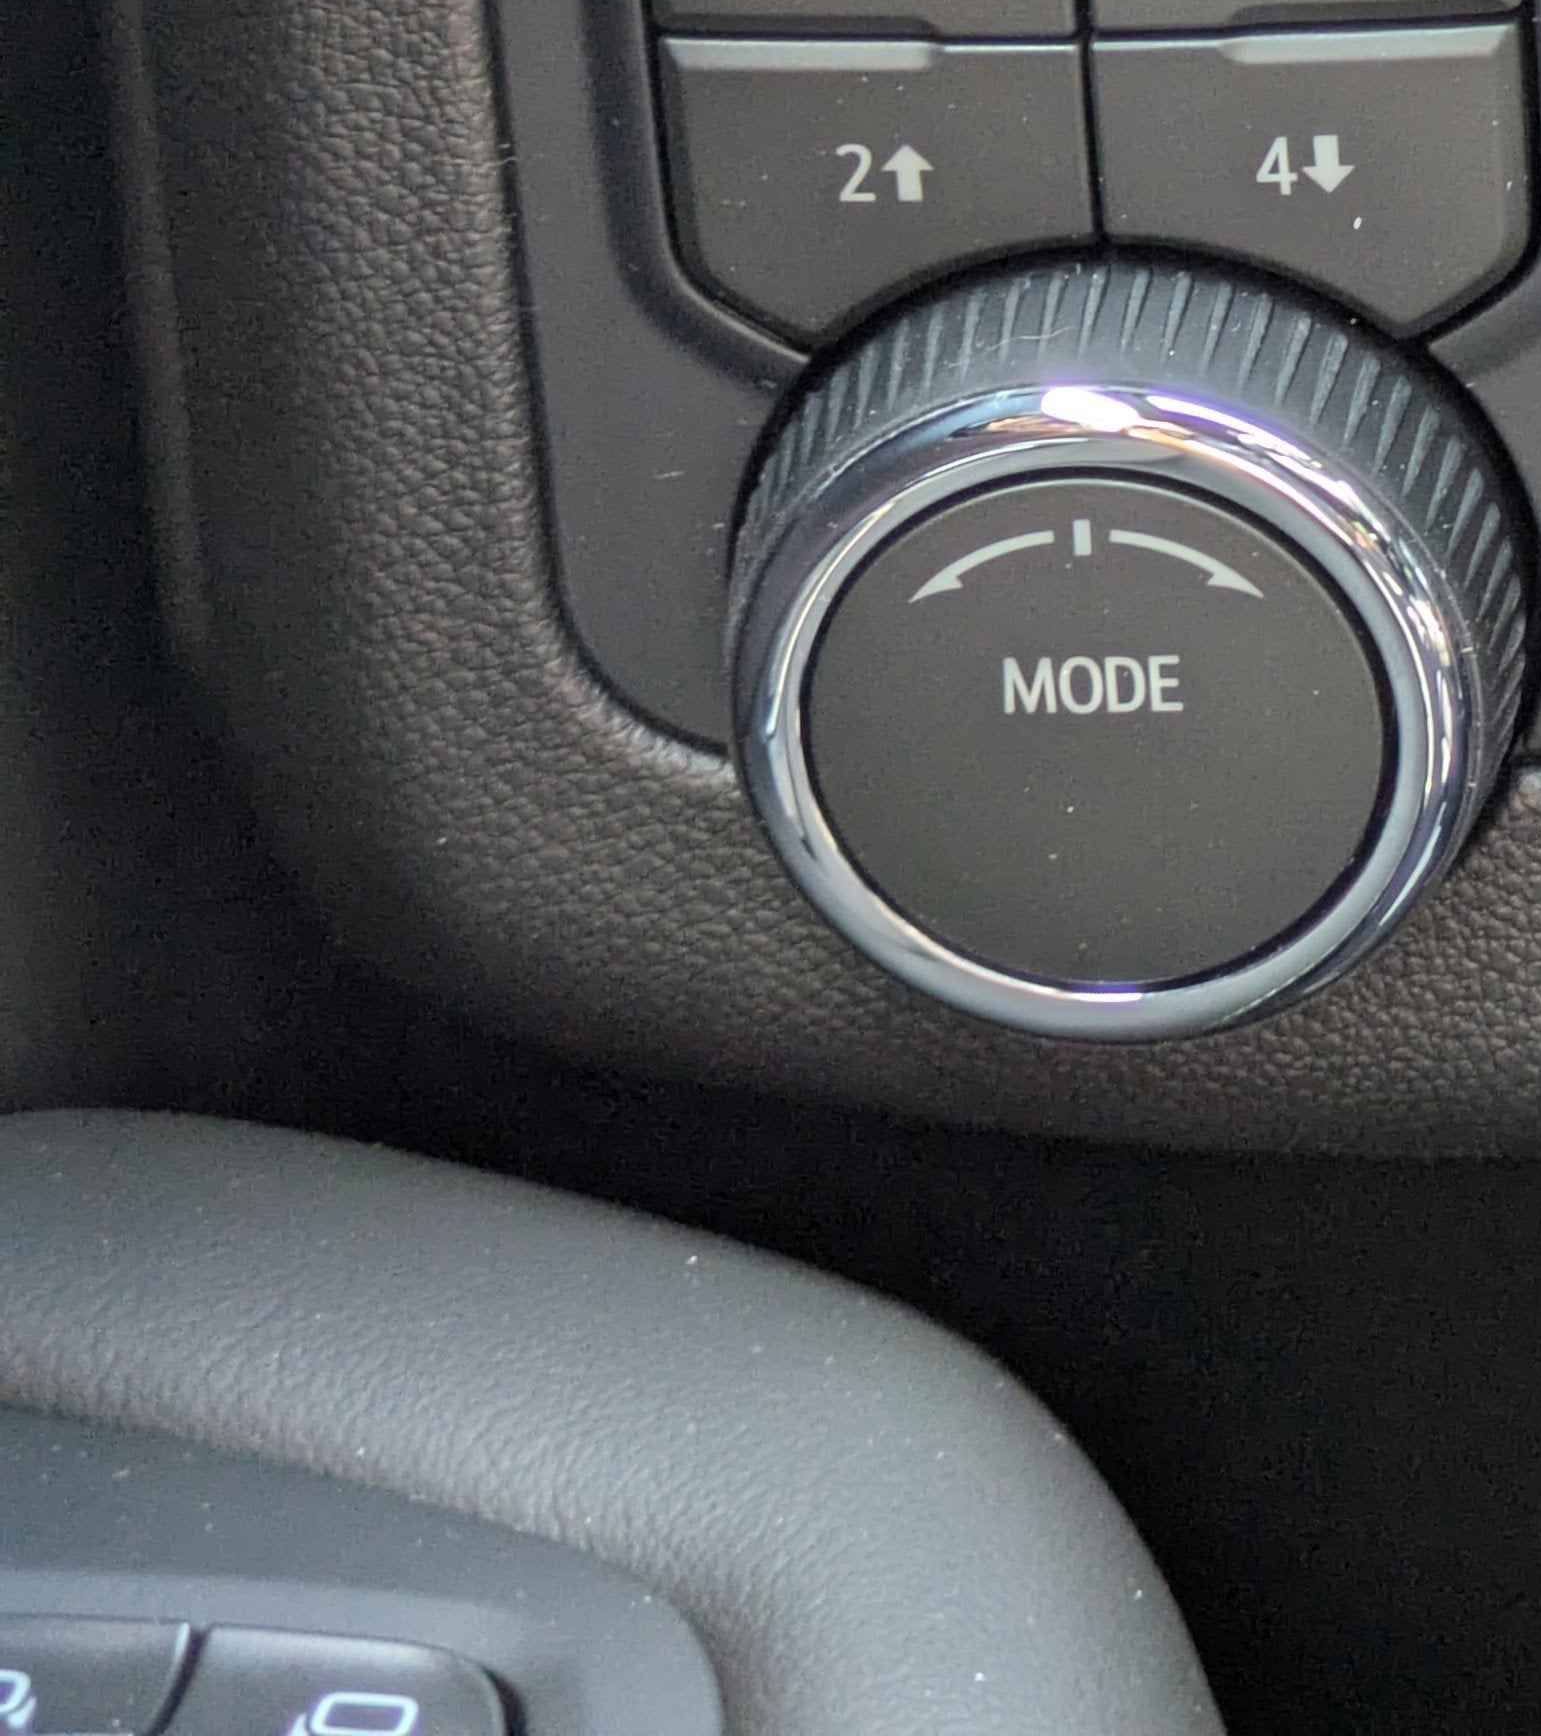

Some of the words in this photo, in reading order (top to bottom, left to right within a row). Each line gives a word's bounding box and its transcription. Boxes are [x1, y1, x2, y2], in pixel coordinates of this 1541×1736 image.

[835, 143, 877, 203] 2
[1255, 137, 1299, 196] 4
[1002, 654, 1185, 715] MODE
